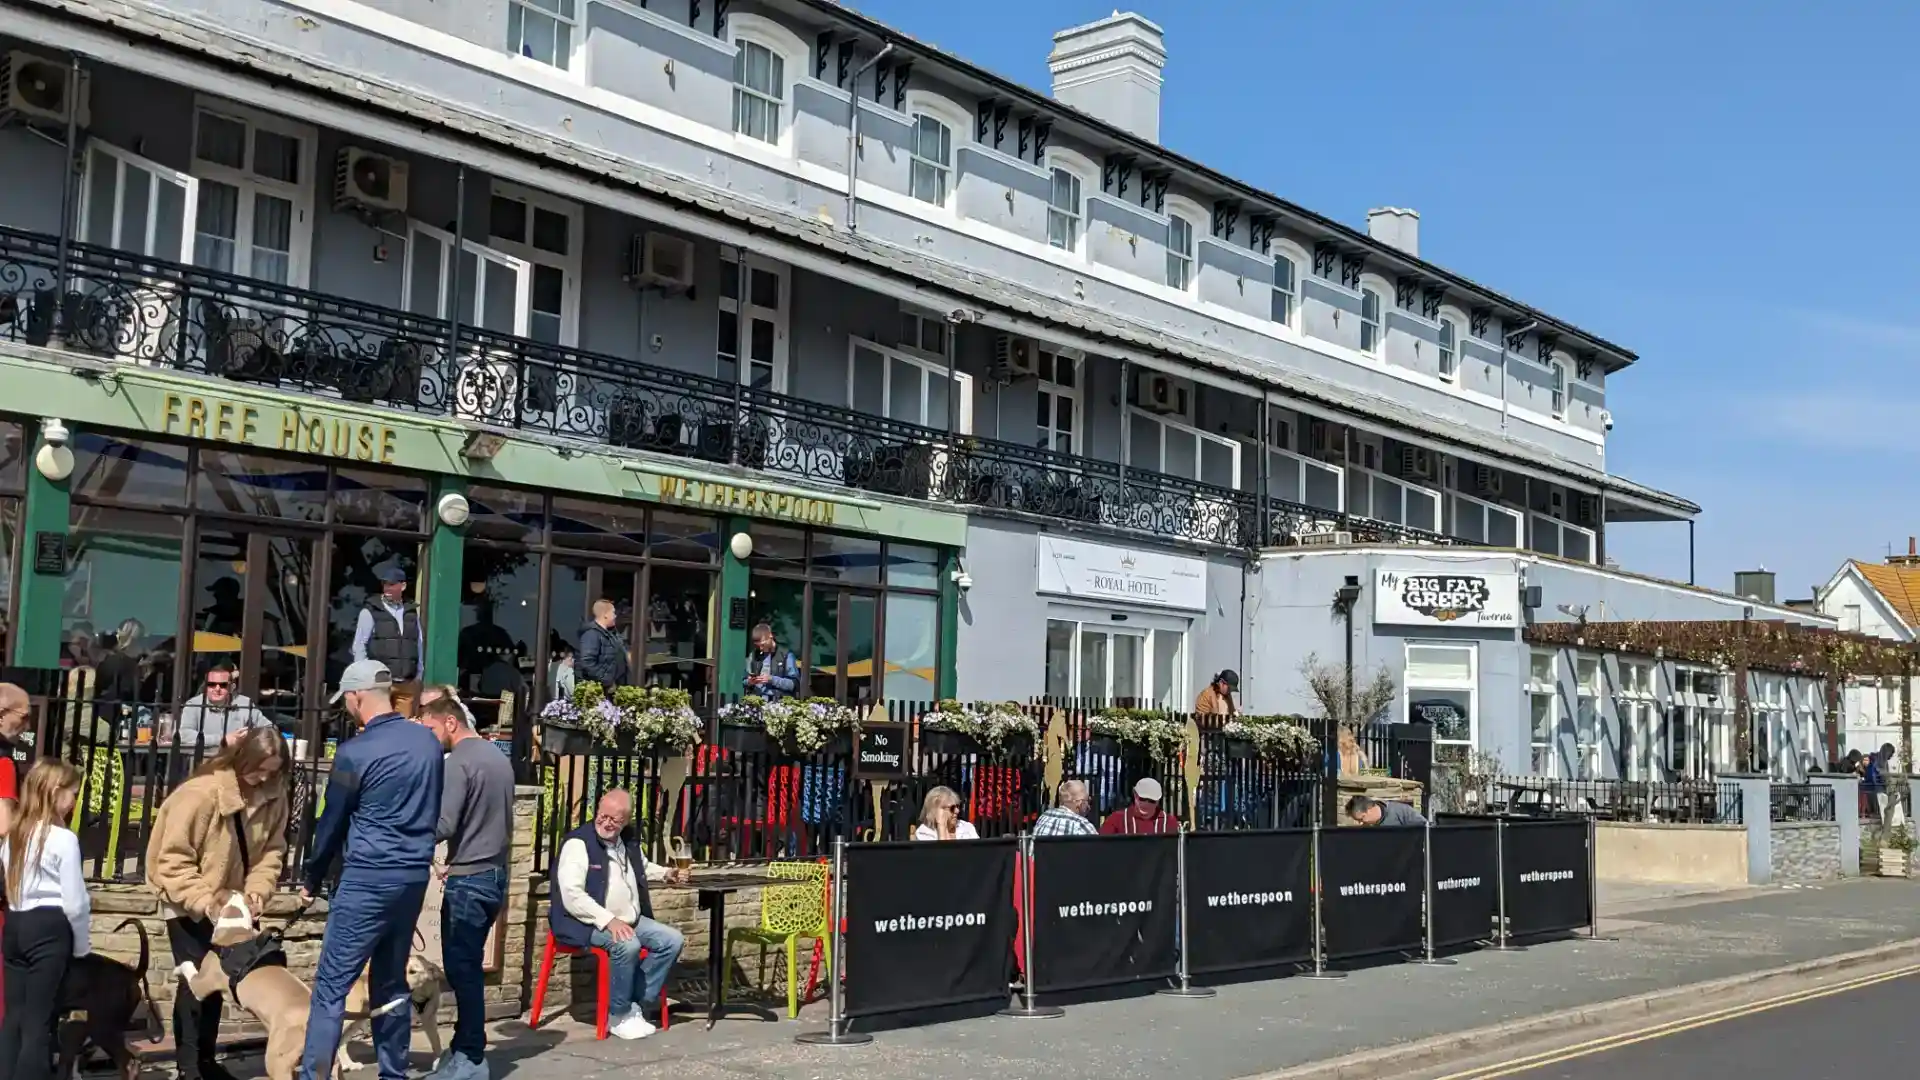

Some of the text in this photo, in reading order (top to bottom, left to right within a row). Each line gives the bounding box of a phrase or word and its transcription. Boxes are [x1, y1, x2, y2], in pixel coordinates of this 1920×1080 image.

[163, 393, 398, 464] FREE HOUSE
[659, 475, 834, 525] WETHERSPOON
[1094, 575, 1160, 596] ROYAL HOTEL
[1381, 572, 1399, 591] My
[1407, 577, 1483, 593] BIG FAT
[1406, 592, 1483, 608] GREEK
[874, 734, 888, 746] No
[861, 751, 899, 767] Smoking
[1437, 876, 1481, 890] wetherspoon
[1520, 870, 1574, 882] wetherspoon
[1340, 881, 1406, 896] wetherspoon
[1208, 890, 1292, 906] wetherspoon
[1059, 900, 1152, 917] wetherspoon
[875, 912, 986, 932] wetherspoon
